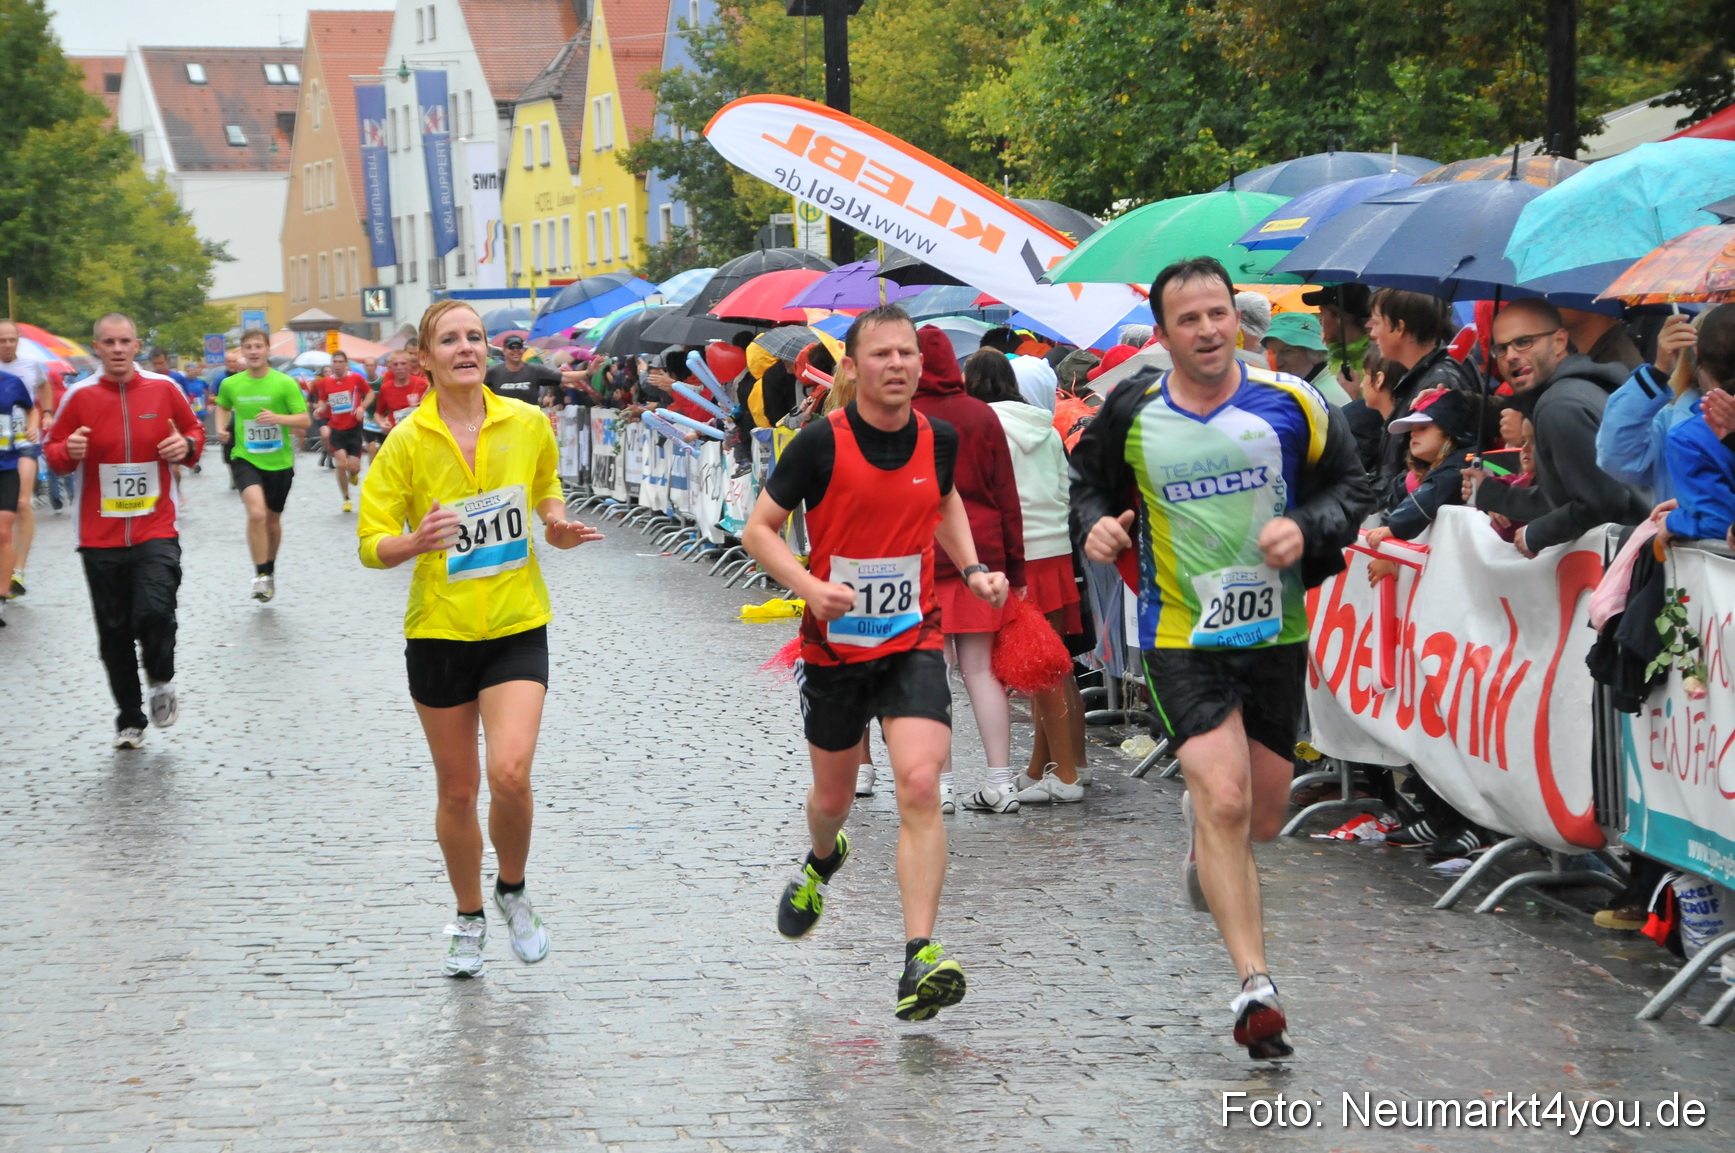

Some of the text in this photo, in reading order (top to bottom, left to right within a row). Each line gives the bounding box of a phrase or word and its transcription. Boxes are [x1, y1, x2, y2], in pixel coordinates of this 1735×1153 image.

[435, 140, 451, 204] RUPPERT
[247, 427, 278, 441] 3107
[1160, 455, 1230, 480] TEAM
[112, 476, 148, 498] 126
[1163, 465, 1269, 503] BOCK
[115, 500, 145, 509] Michael
[453, 507, 523, 553] 3410
[1203, 587, 1274, 629] 2803
[857, 620, 893, 635] Oliver
[1217, 628, 1263, 646] Gerhard
